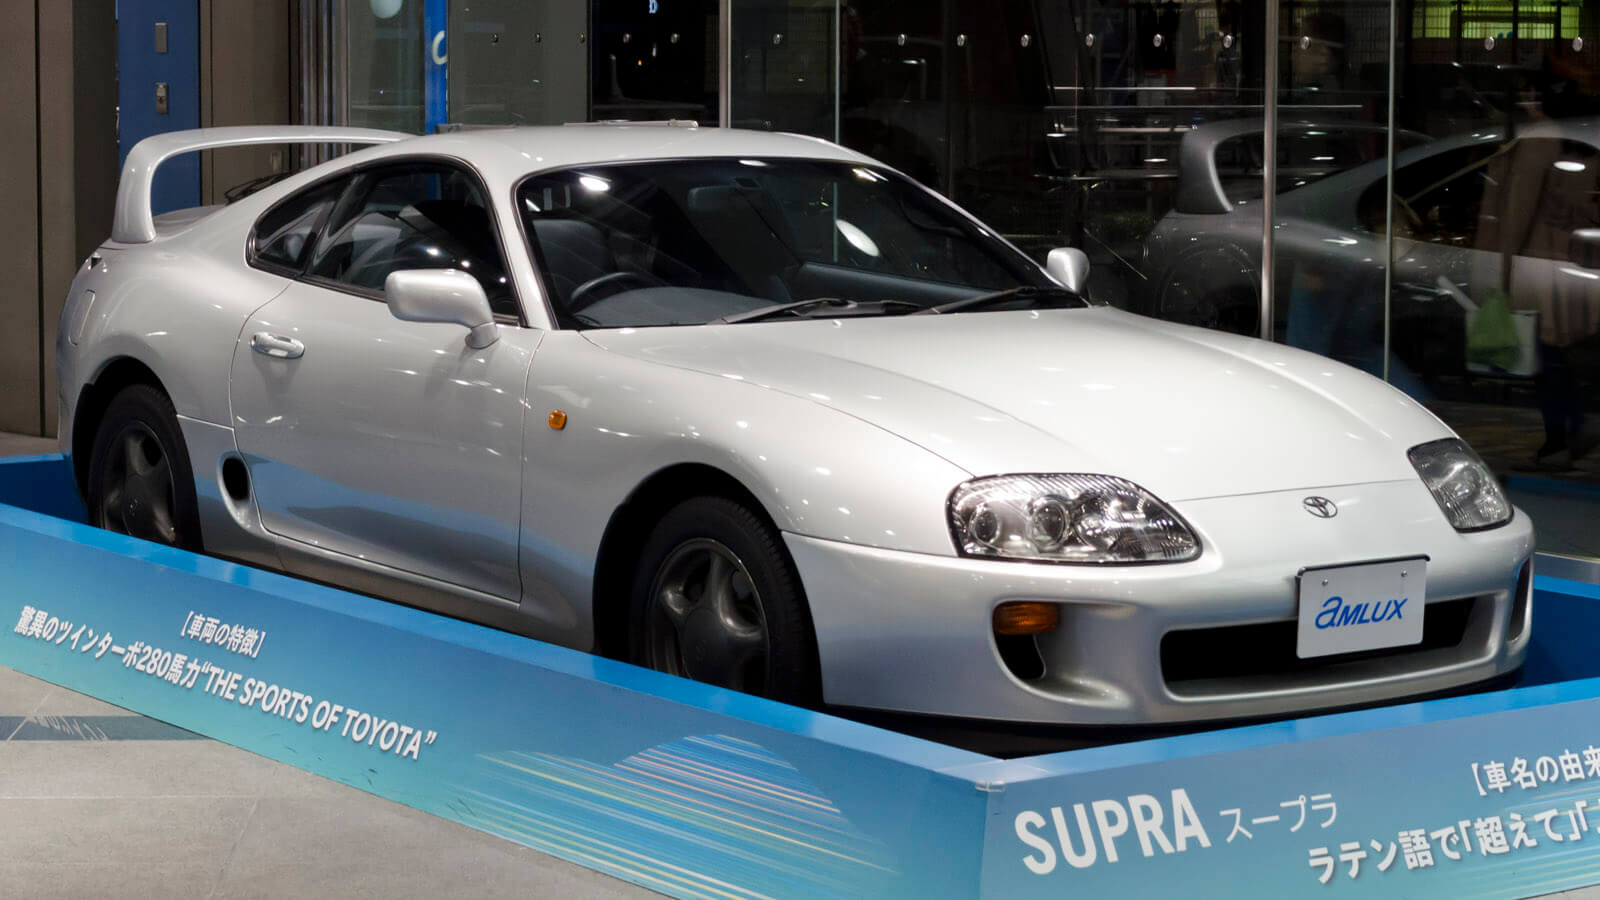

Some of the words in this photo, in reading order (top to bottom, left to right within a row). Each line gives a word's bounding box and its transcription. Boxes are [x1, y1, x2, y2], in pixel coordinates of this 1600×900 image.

[239, 677, 313, 723] SPORTS
[311, 700, 343, 731] OF
[1014, 788, 1212, 875] SUPRA
[1219, 793, 1337, 843] スープラ
[1308, 798, 1600, 884] ラテン語で「超えて」「
